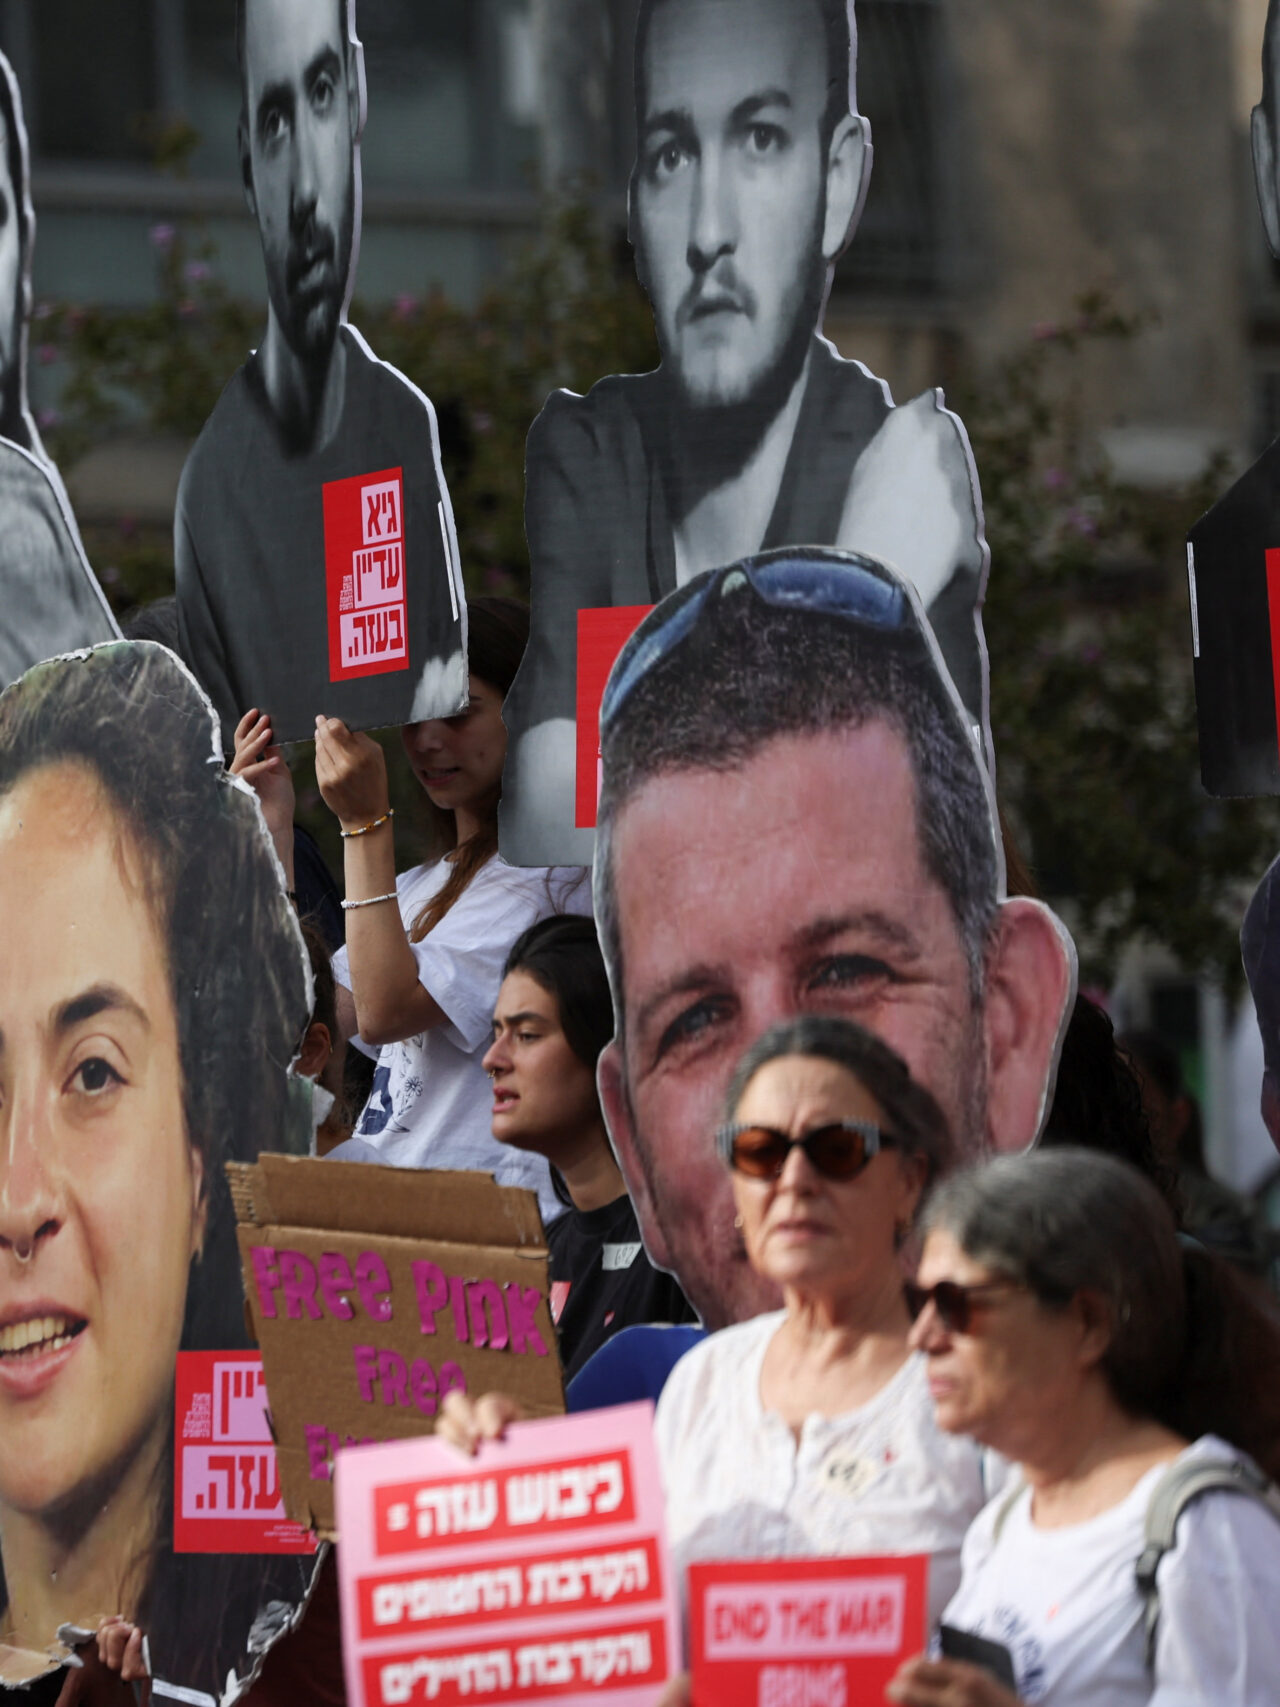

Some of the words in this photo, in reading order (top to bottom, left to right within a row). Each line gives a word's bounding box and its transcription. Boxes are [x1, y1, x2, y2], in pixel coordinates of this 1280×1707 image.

[367, 491, 398, 538] גיא
[356, 547, 400, 602] עדיין
[348, 609, 403, 658] בעזה.
[196, 1455, 282, 1510] עזה.
[416, 1479, 499, 1538] עזה
[508, 1460, 625, 1526] כיבוש
[373, 1566, 523, 1625] החטופים
[527, 1548, 651, 1606] הקרבת
[713, 1603, 766, 1642] END
[778, 1599, 828, 1640] THE
[837, 1595, 893, 1636] WAR
[516, 1631, 652, 1691] והקרבת
